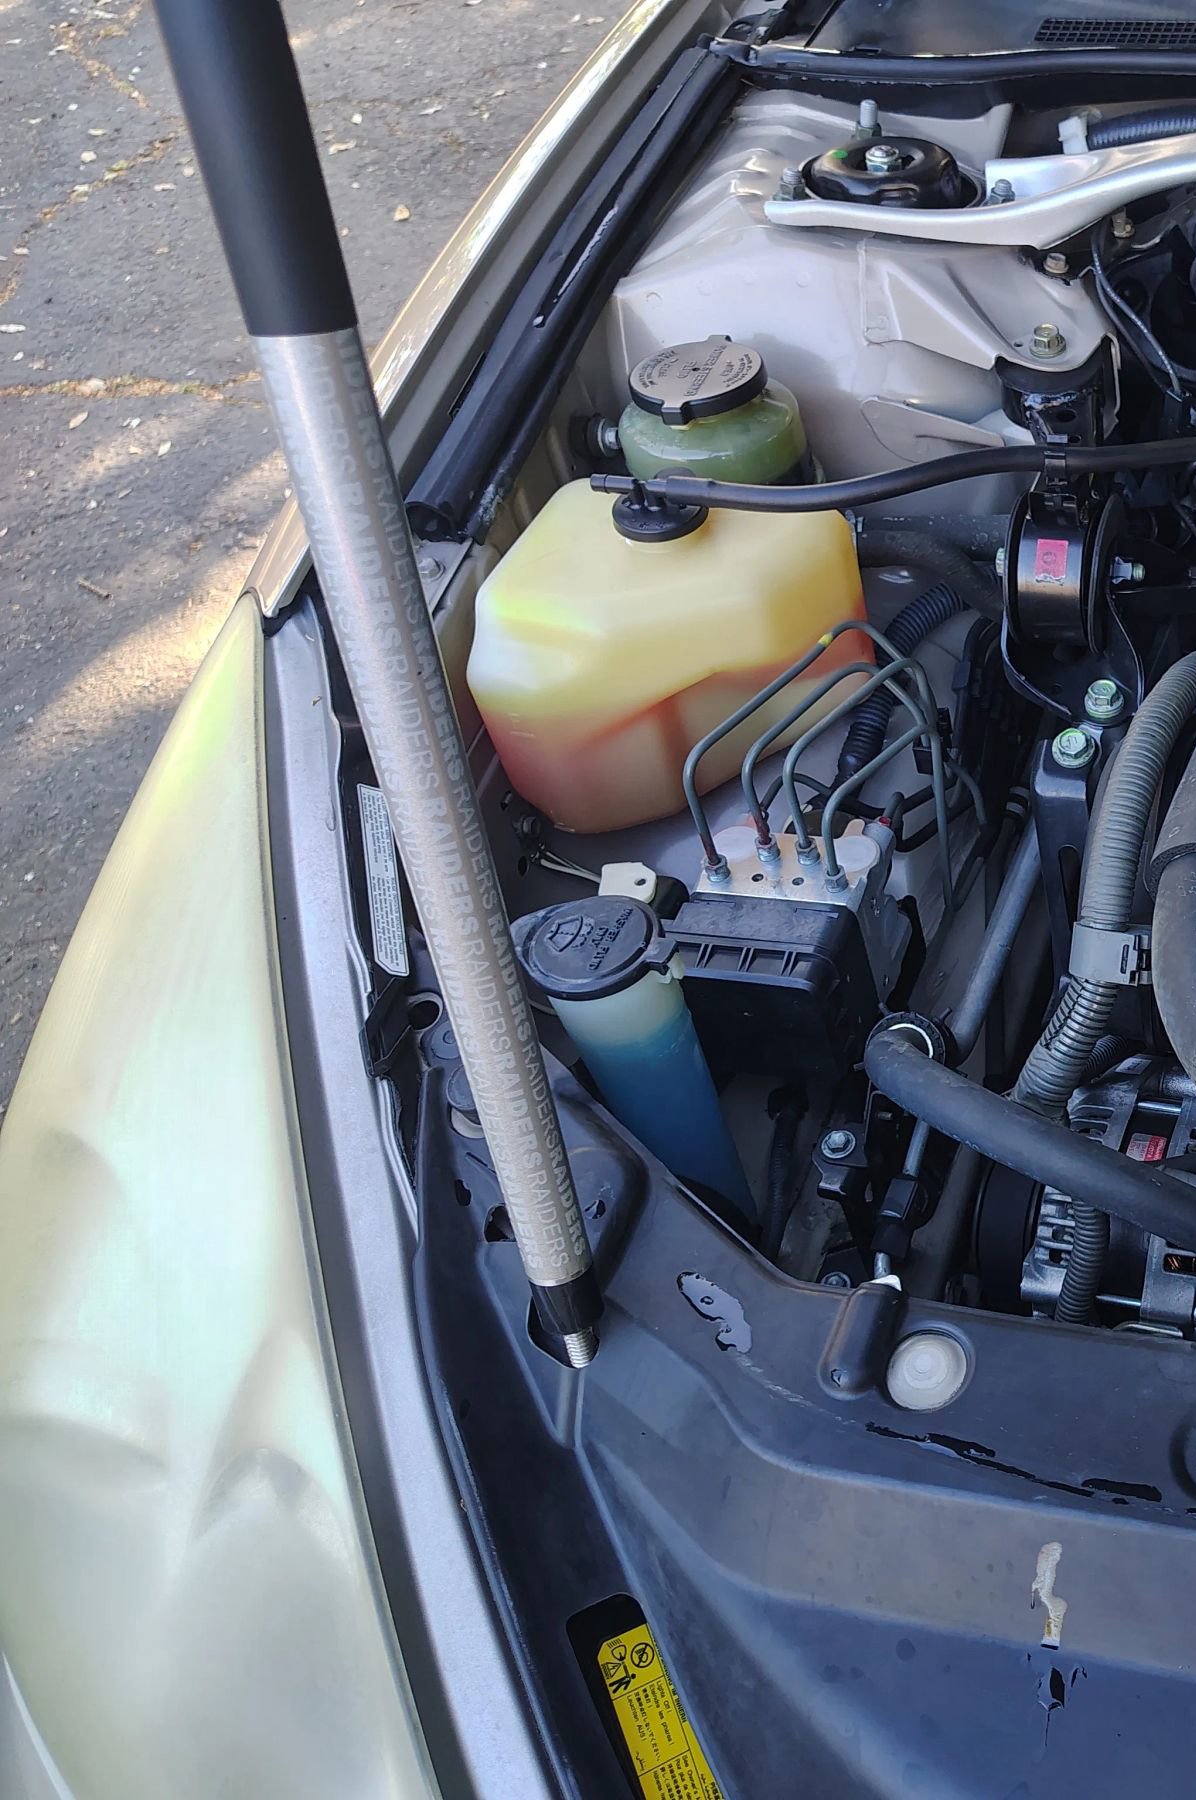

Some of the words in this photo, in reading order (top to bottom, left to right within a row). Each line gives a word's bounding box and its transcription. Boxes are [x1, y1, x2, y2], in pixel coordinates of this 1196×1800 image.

[336, 478, 403, 651] RAIDERS
[381, 652, 441, 792] RAIDERS
[420, 794, 480, 937] RAIDERS
[460, 936, 513, 1056] RAIDERS
[492, 1050, 543, 1170] RAIDERS
[525, 1169, 569, 1269] RAIDERS
[343, 635, 405, 795] RAIDERS
[389, 793, 442, 923] RAIDERS
[428, 924, 481, 1057] RAIDERS
[466, 1053, 513, 1164] RAIDERS
[497, 1158, 544, 1271] RAIDERS
[371, 474, 425, 625] RAIDERS
[410, 628, 466, 782] RAIDERS
[451, 782, 499, 910] RAIDERS
[485, 911, 533, 1042] RAIDERS
[519, 1043, 561, 1151] RAIDERS
[546, 1145, 588, 1257] RAIDERS
